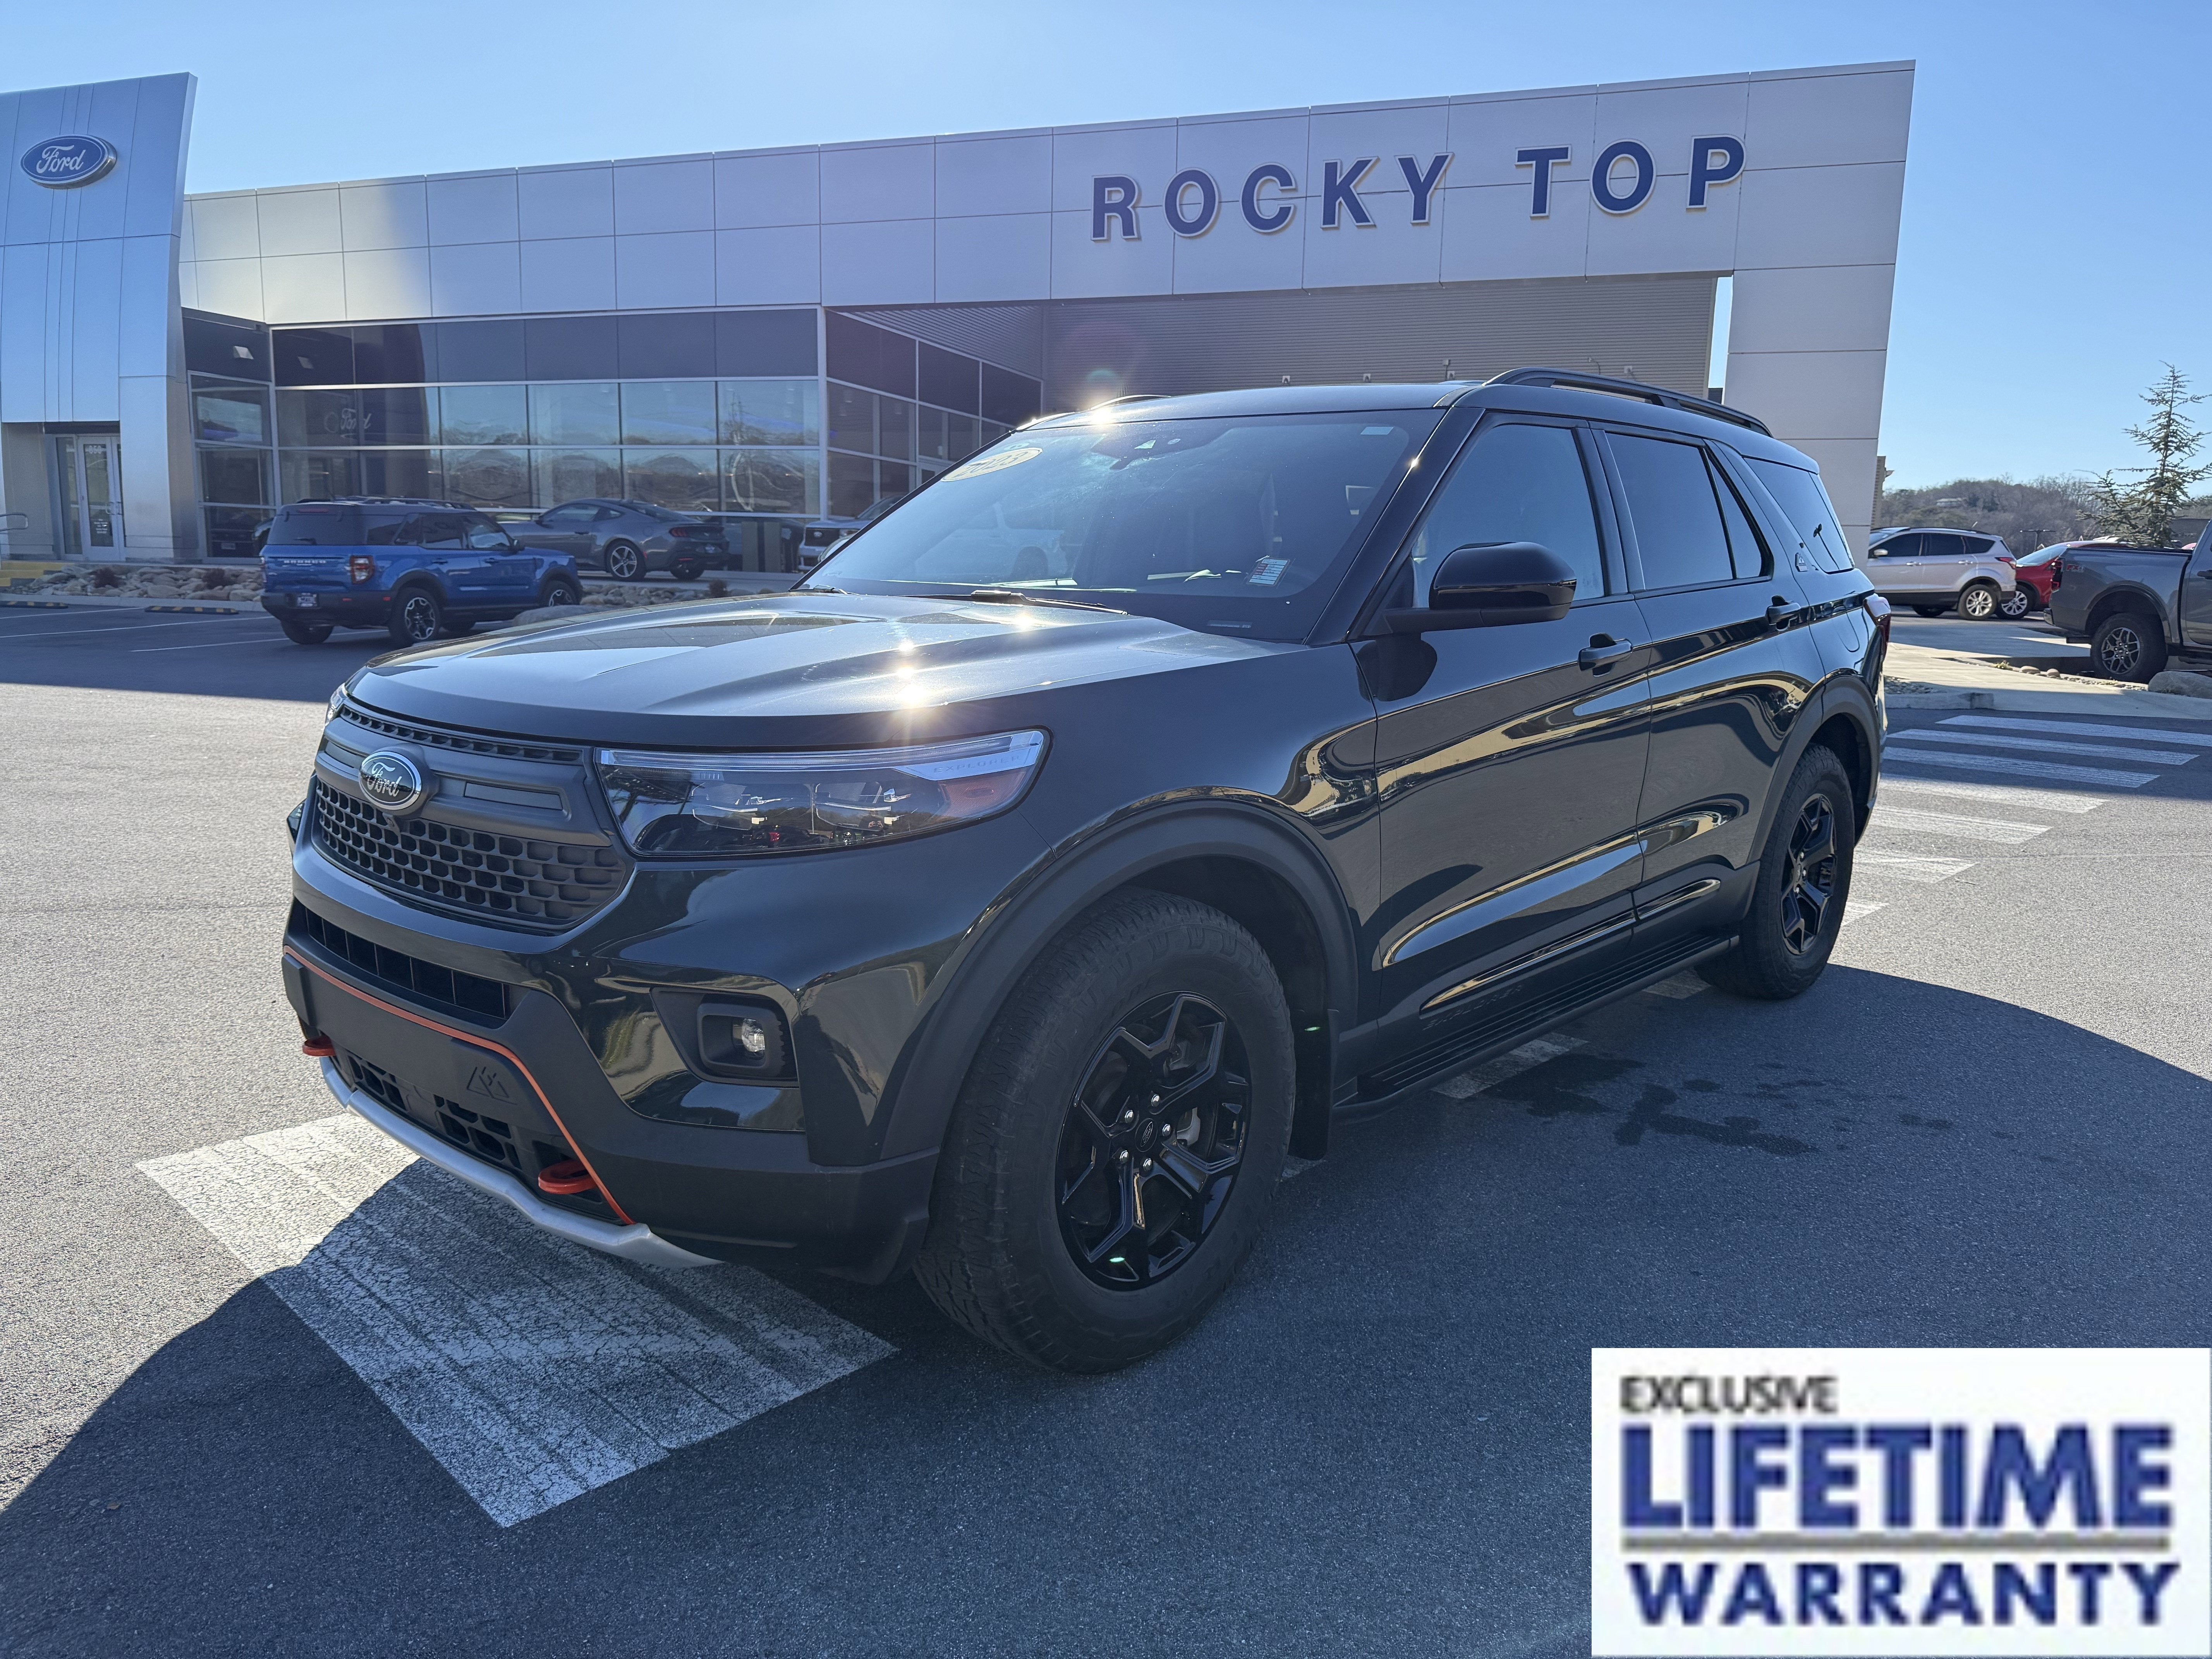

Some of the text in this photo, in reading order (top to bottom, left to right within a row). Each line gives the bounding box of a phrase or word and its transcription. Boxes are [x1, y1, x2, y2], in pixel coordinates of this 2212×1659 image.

[36, 145, 86, 173] Ford
[1091, 134, 1746, 241] ROCKY TOP
[951, 451, 1029, 479] 2023
[933, 756, 1020, 773] EXPLORER
[366, 762, 403, 797] Ford
